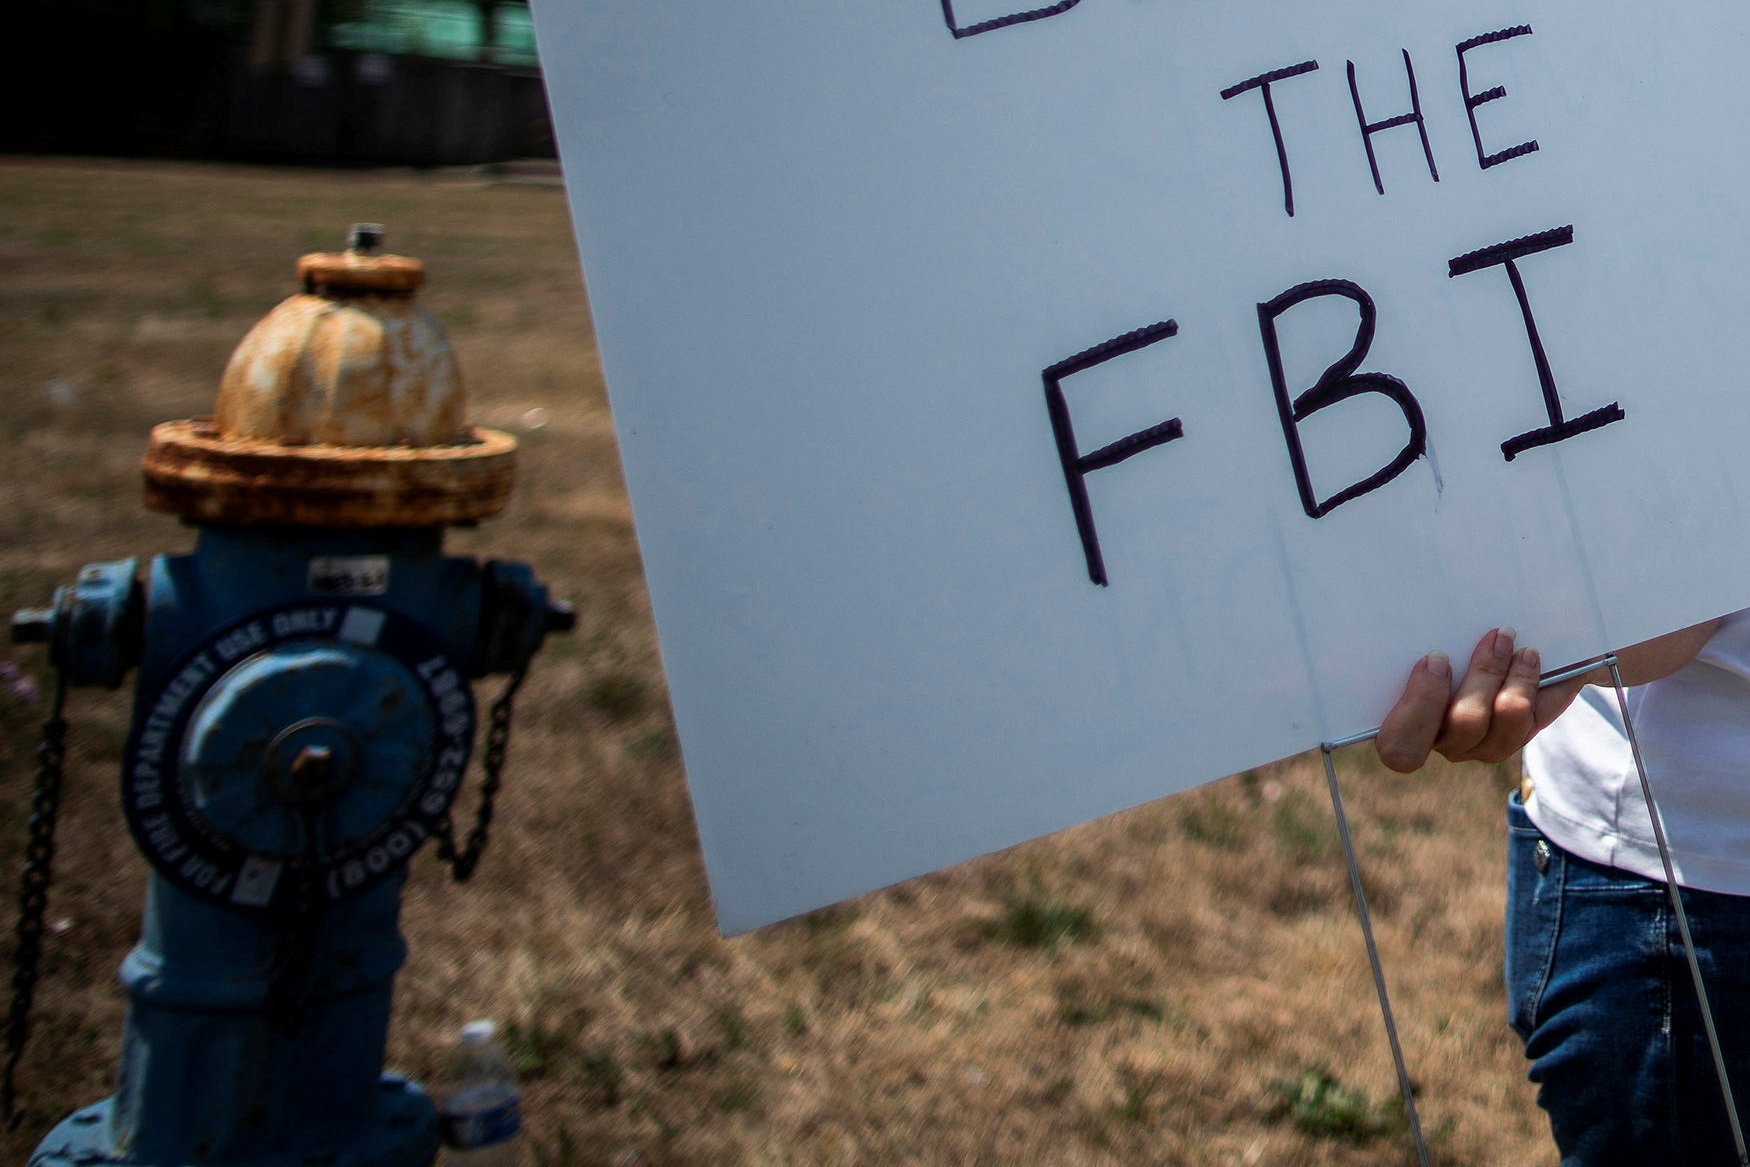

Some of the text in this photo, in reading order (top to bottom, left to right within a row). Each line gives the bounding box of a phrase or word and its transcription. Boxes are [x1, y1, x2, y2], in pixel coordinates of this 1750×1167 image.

[1220, 24, 1540, 217] THE
[1042, 224, 1625, 587] FBI
[133, 607, 338, 897] FOR FIRE DEPARTMENT USE ONLY
